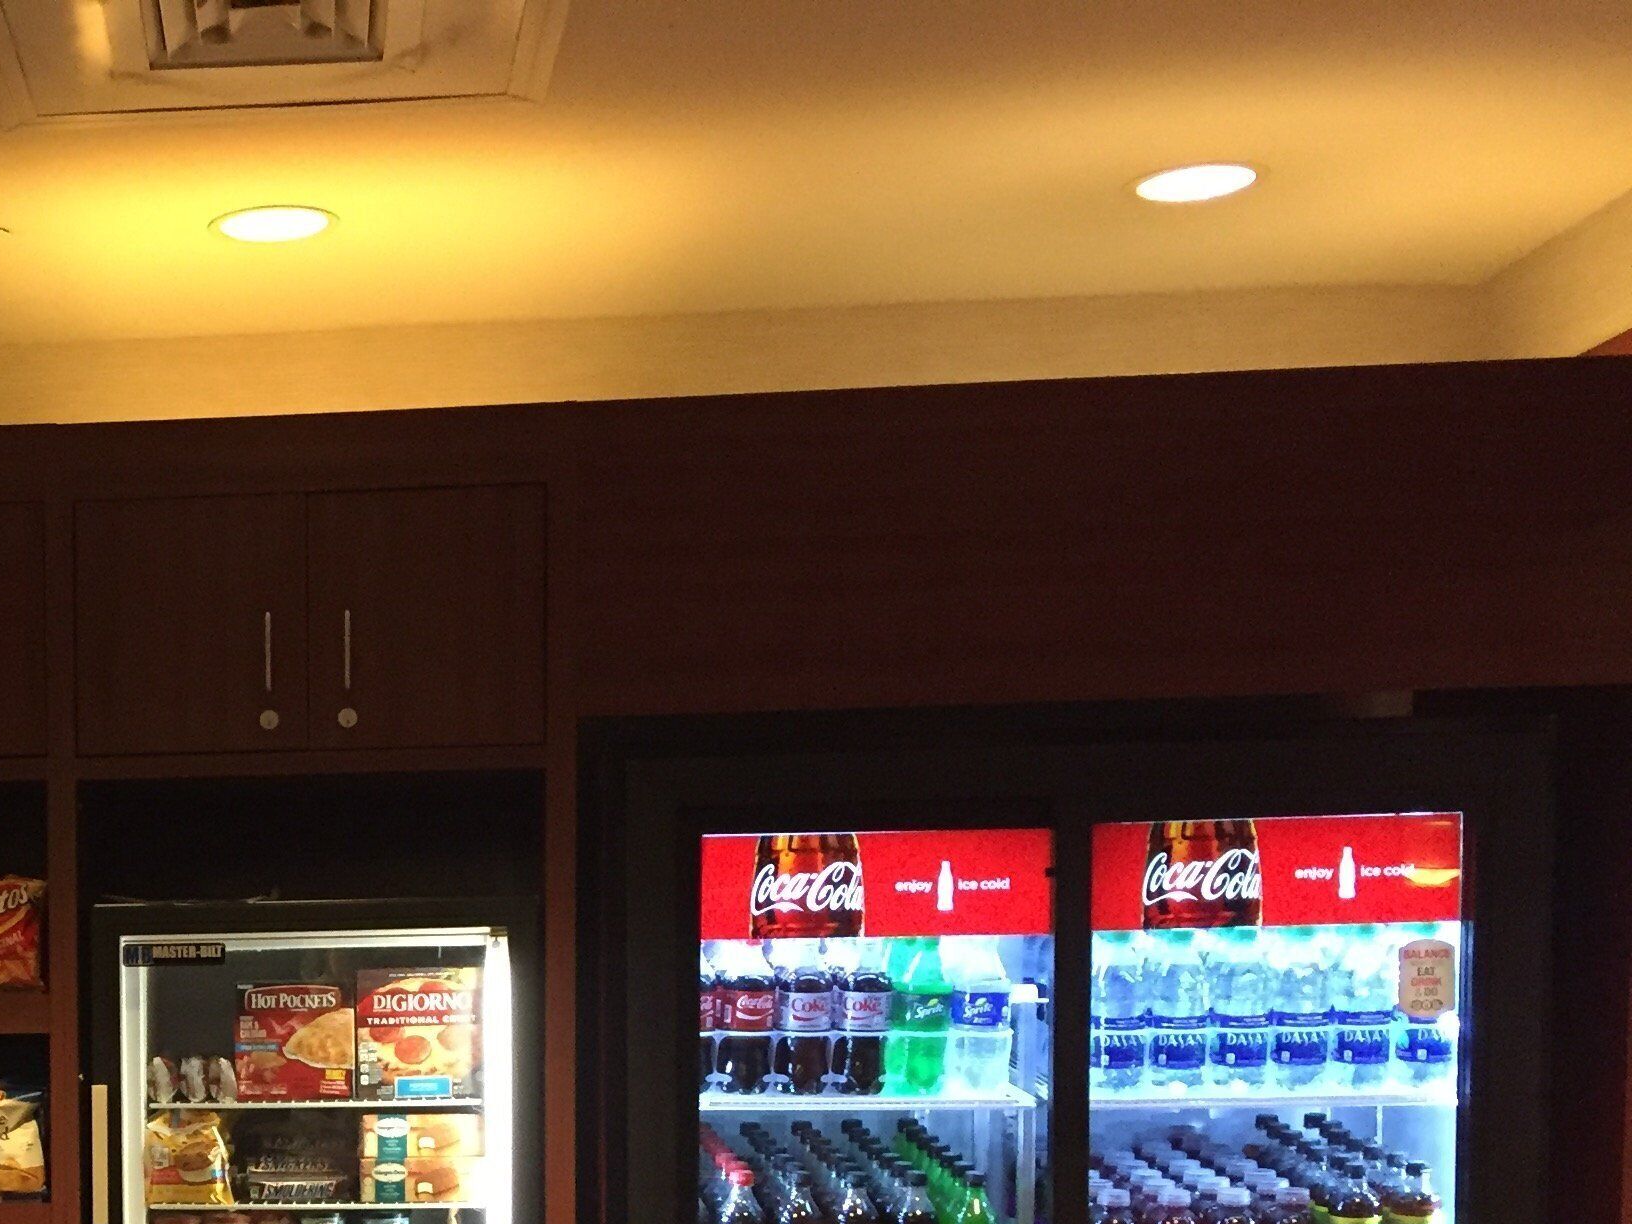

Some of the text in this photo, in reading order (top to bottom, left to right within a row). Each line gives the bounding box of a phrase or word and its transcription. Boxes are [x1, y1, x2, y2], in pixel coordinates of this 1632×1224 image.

[1143, 848, 1262, 906] Coca-Cola
[1294, 866, 1334, 880] enjoy
[1360, 864, 1415, 877] ice cold
[750, 861, 864, 916] Coca-Cola
[894, 880, 933, 894] enjoy
[958, 877, 1011, 890] ice cold
[251, 991, 336, 1009] HOT POCKETS
[367, 1015, 439, 1025] TRADITIONAL
